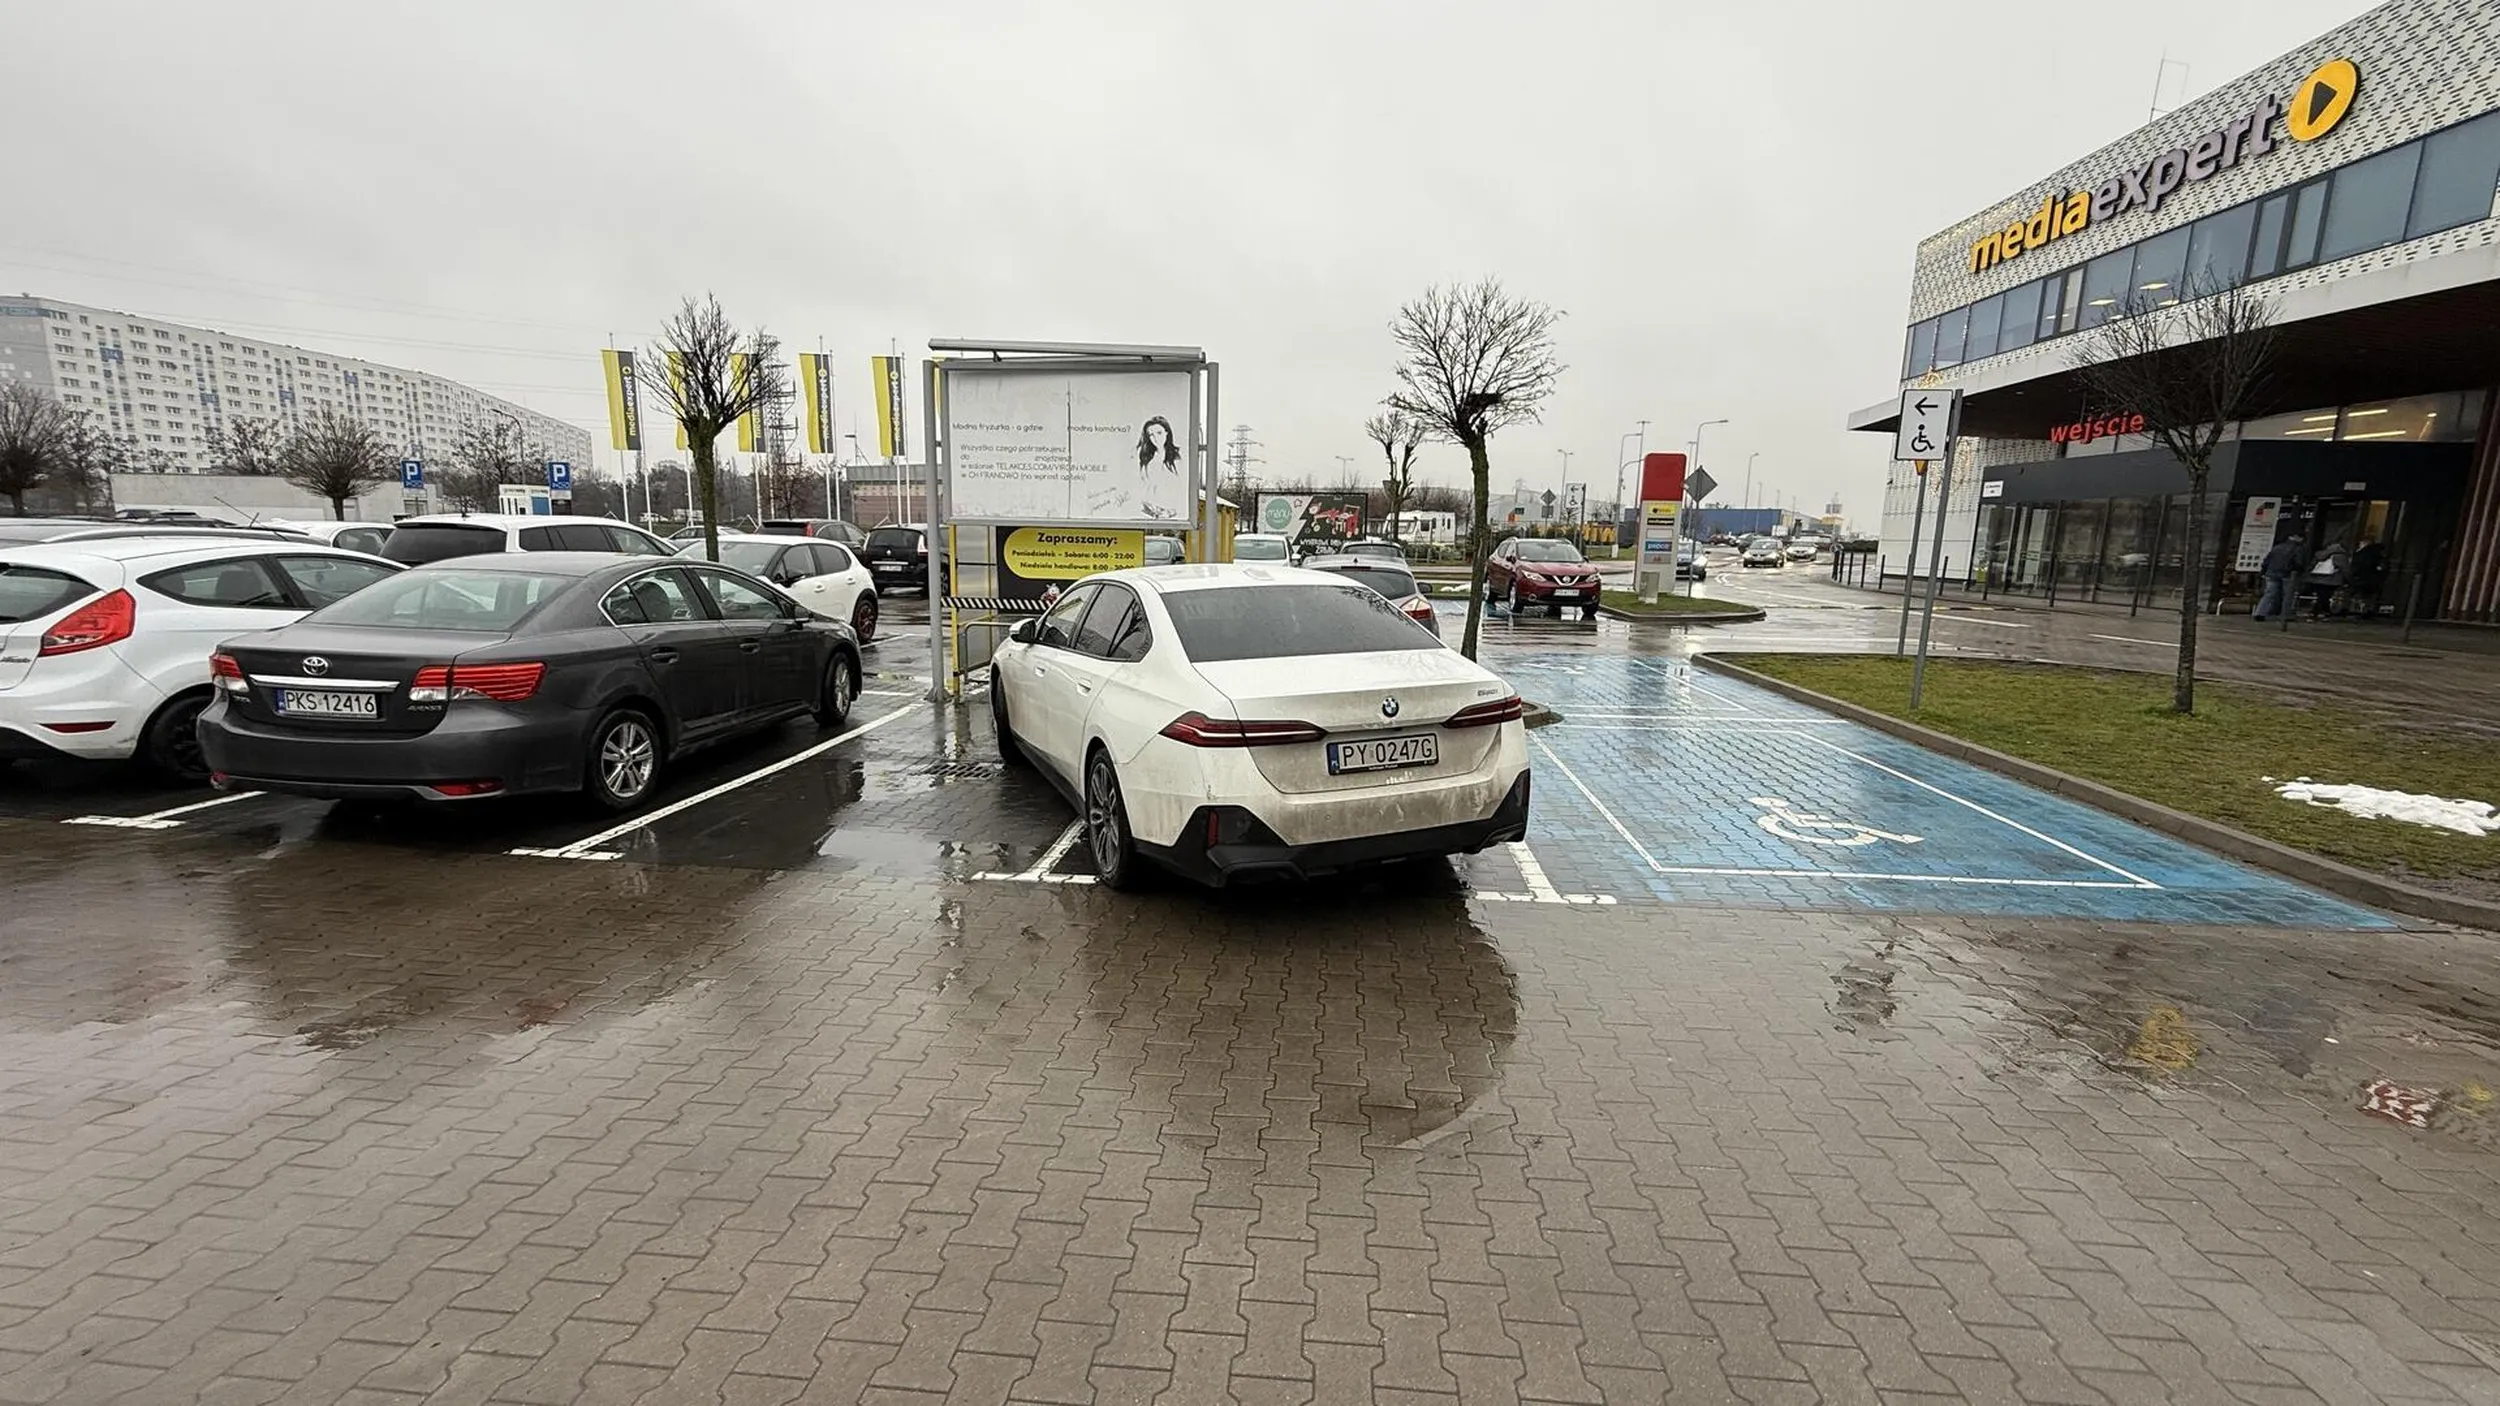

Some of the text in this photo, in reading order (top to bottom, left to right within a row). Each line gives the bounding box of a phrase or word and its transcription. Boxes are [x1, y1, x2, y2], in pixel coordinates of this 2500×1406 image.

[1970, 94, 2282, 273] mediaexpert
[623, 375, 637, 436] mediaexpert
[2051, 411, 2144, 444] wejście
[405, 463, 419, 480] P
[552, 464, 565, 482] P
[1037, 532, 1118, 547] Zapraszamy:
[1114, 552, 1135, 560] 22:00
[286, 691, 375, 712] PKS 12416
[1343, 738, 1433, 767] PY 0247G
